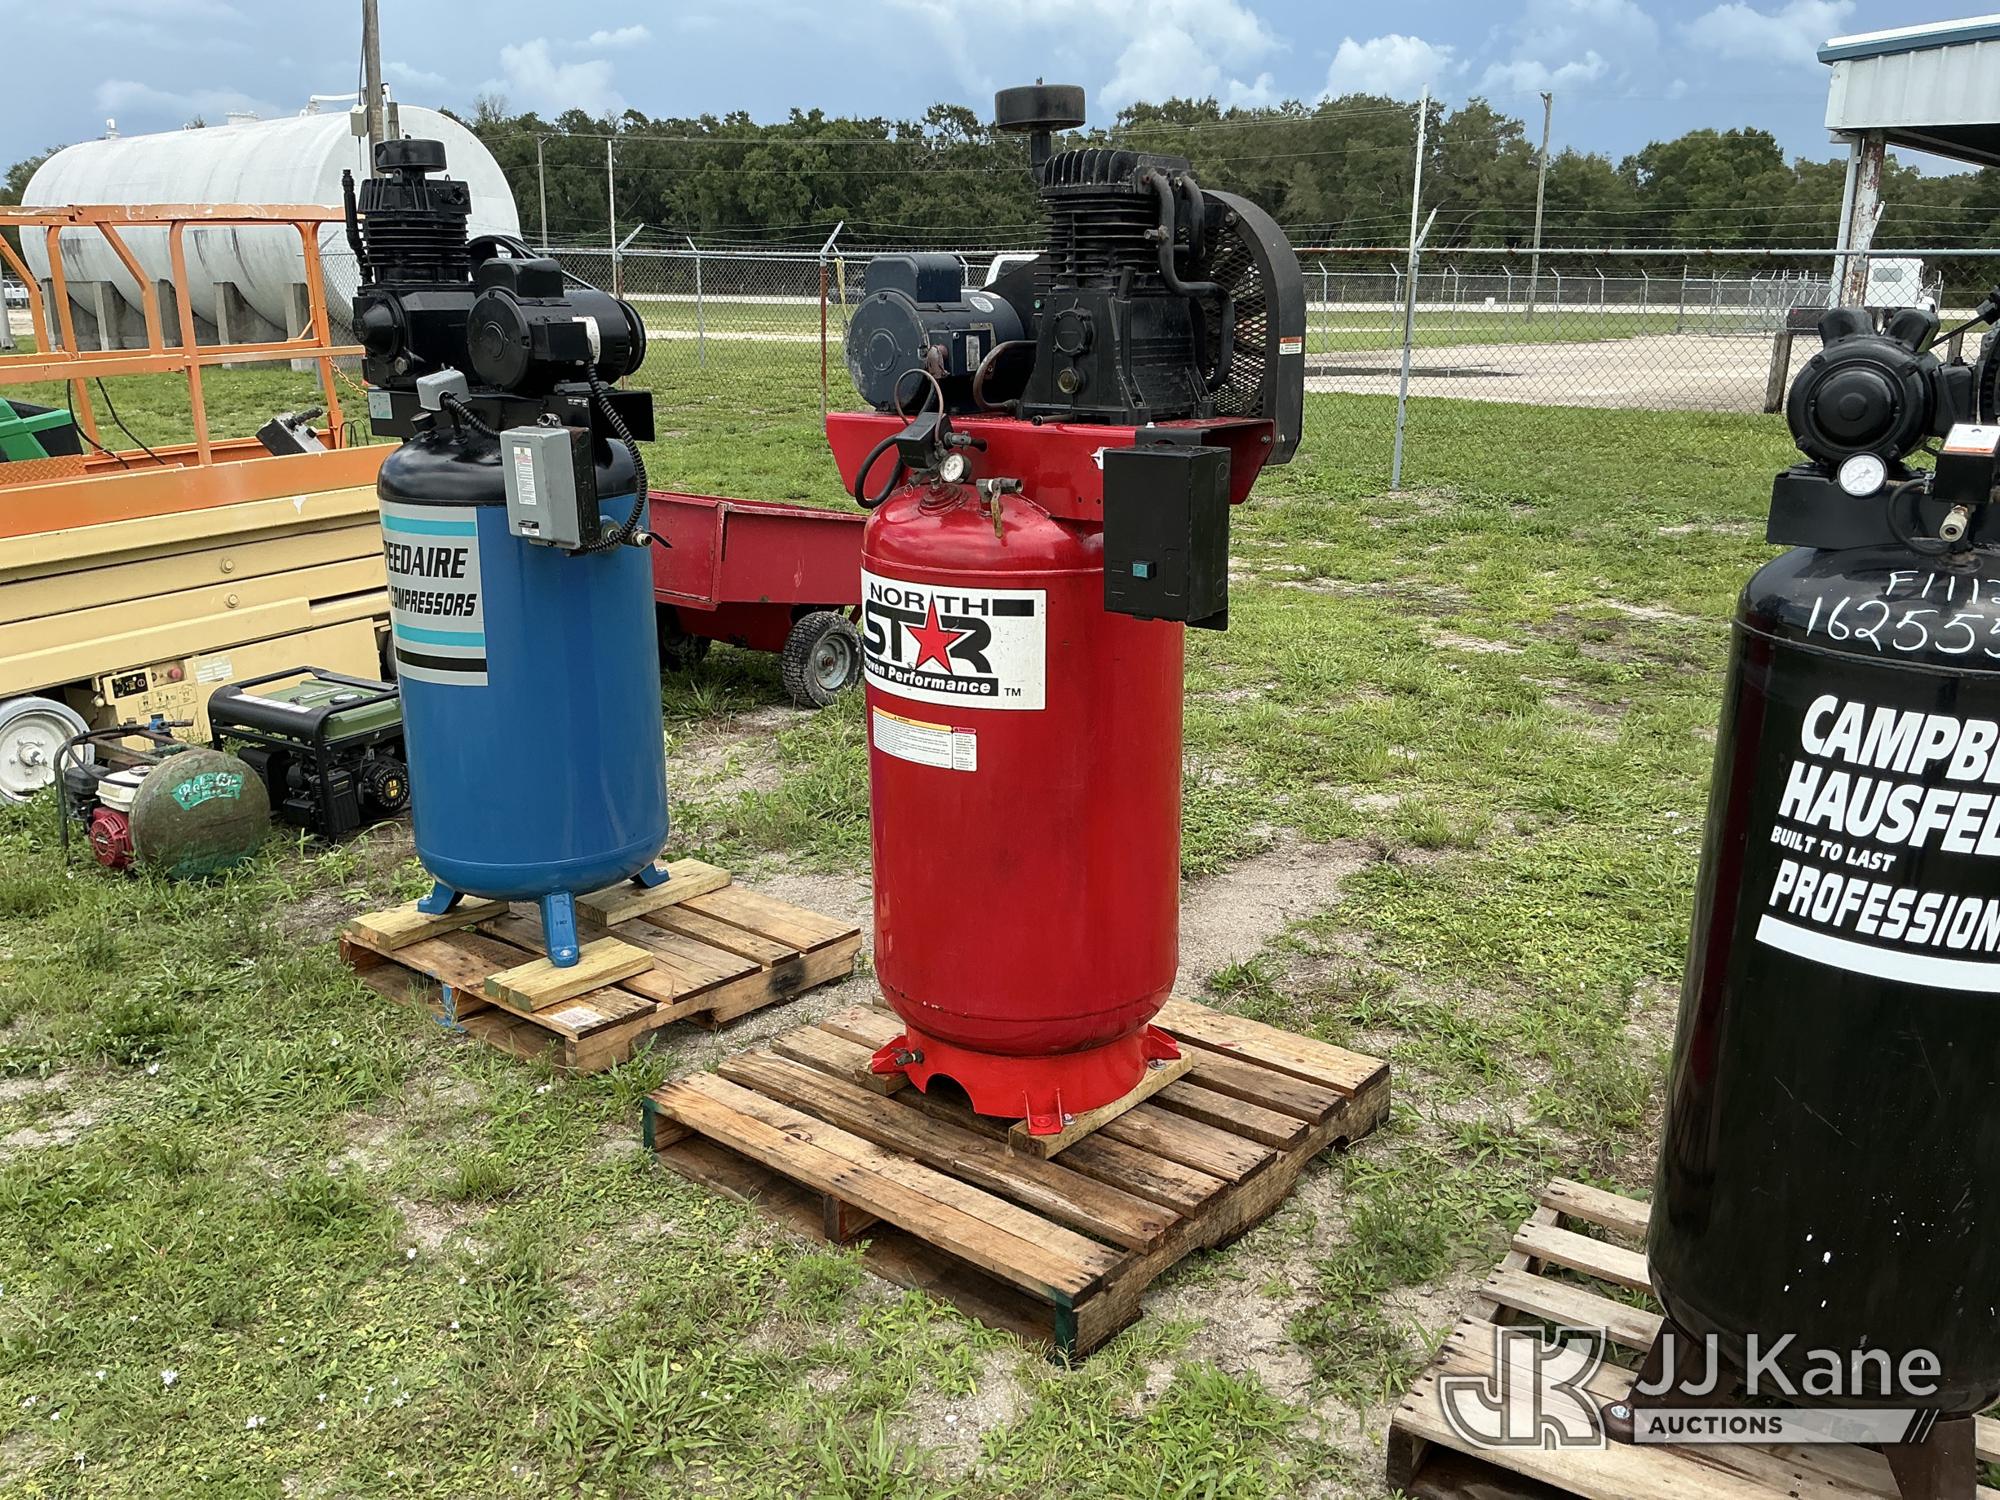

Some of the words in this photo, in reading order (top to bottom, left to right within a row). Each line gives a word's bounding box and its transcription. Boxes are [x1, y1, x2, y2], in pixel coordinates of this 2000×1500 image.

[870, 582, 989, 617] NORTH
[888, 667, 991, 694] Performance
[1770, 826, 1816, 852] BUILT
[1820, 840, 1844, 862] TO
[1845, 847, 1897, 873] LAST
[1768, 859, 2000, 953] PROFESSION
